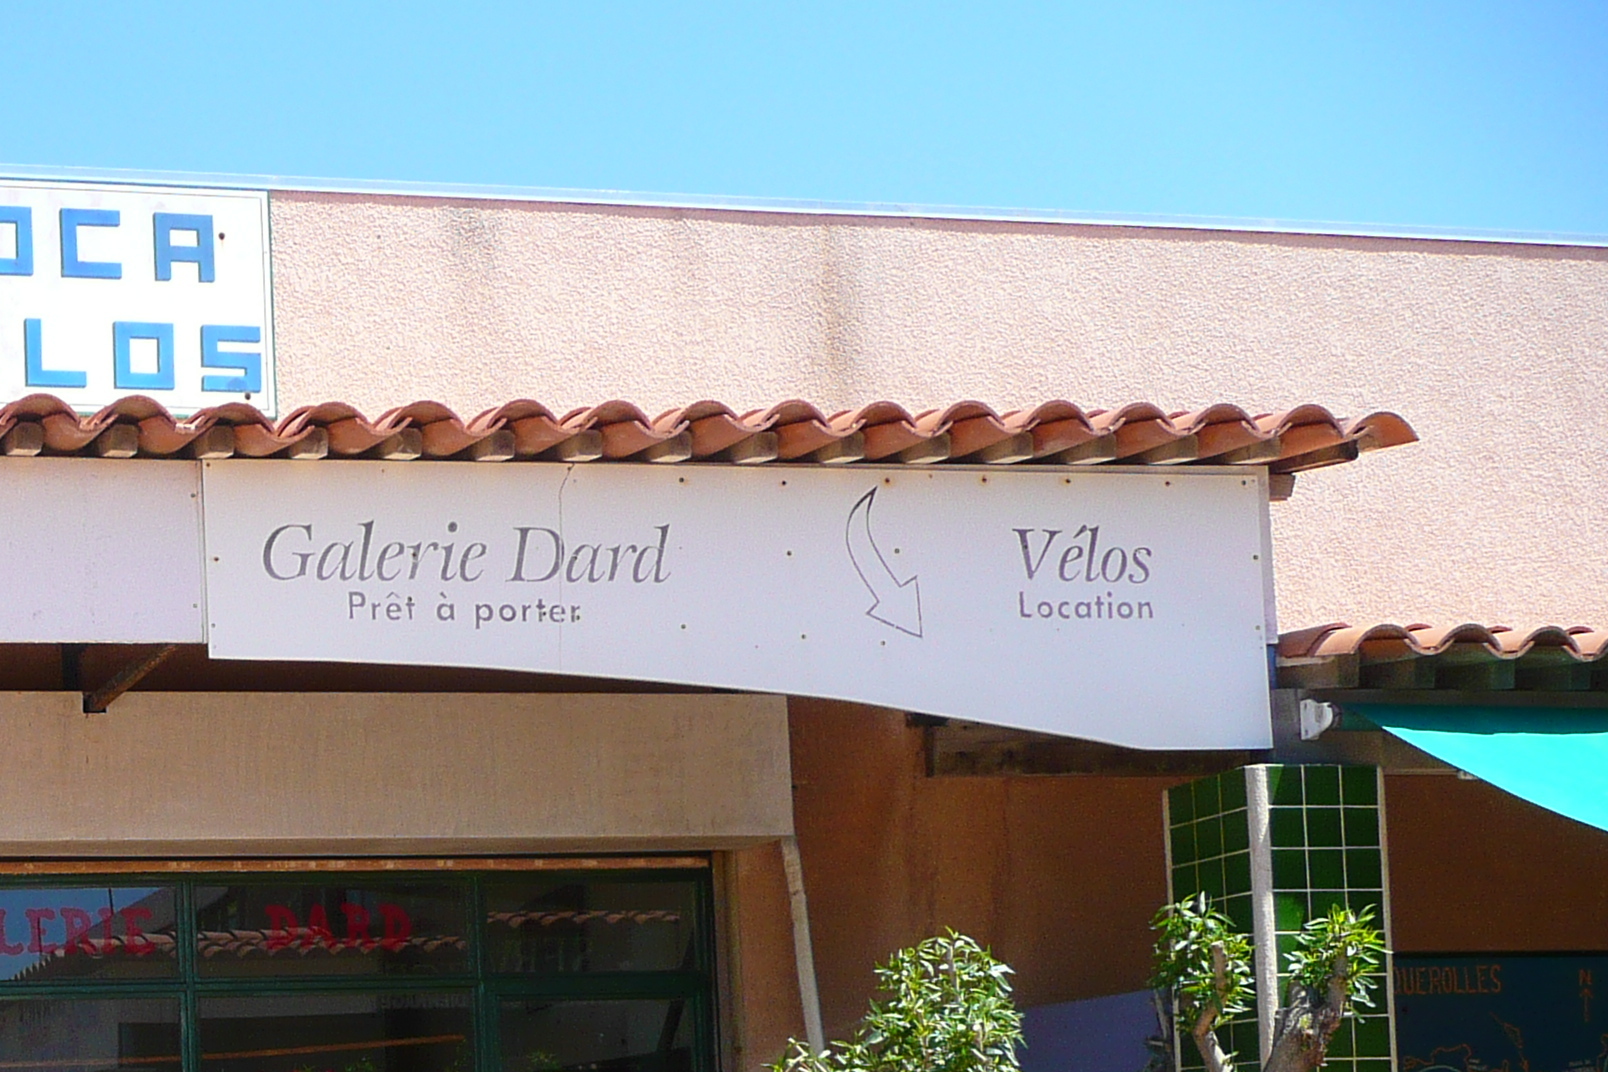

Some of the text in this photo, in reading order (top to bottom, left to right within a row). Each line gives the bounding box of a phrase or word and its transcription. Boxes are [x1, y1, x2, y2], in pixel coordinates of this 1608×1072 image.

[262, 520, 672, 584] Galerie Dard
[1012, 525, 1153, 585] Vélos
[347, 590, 582, 629] Prêt à porter
[1019, 591, 1154, 620] Location
[264, 903, 413, 953] DARD
